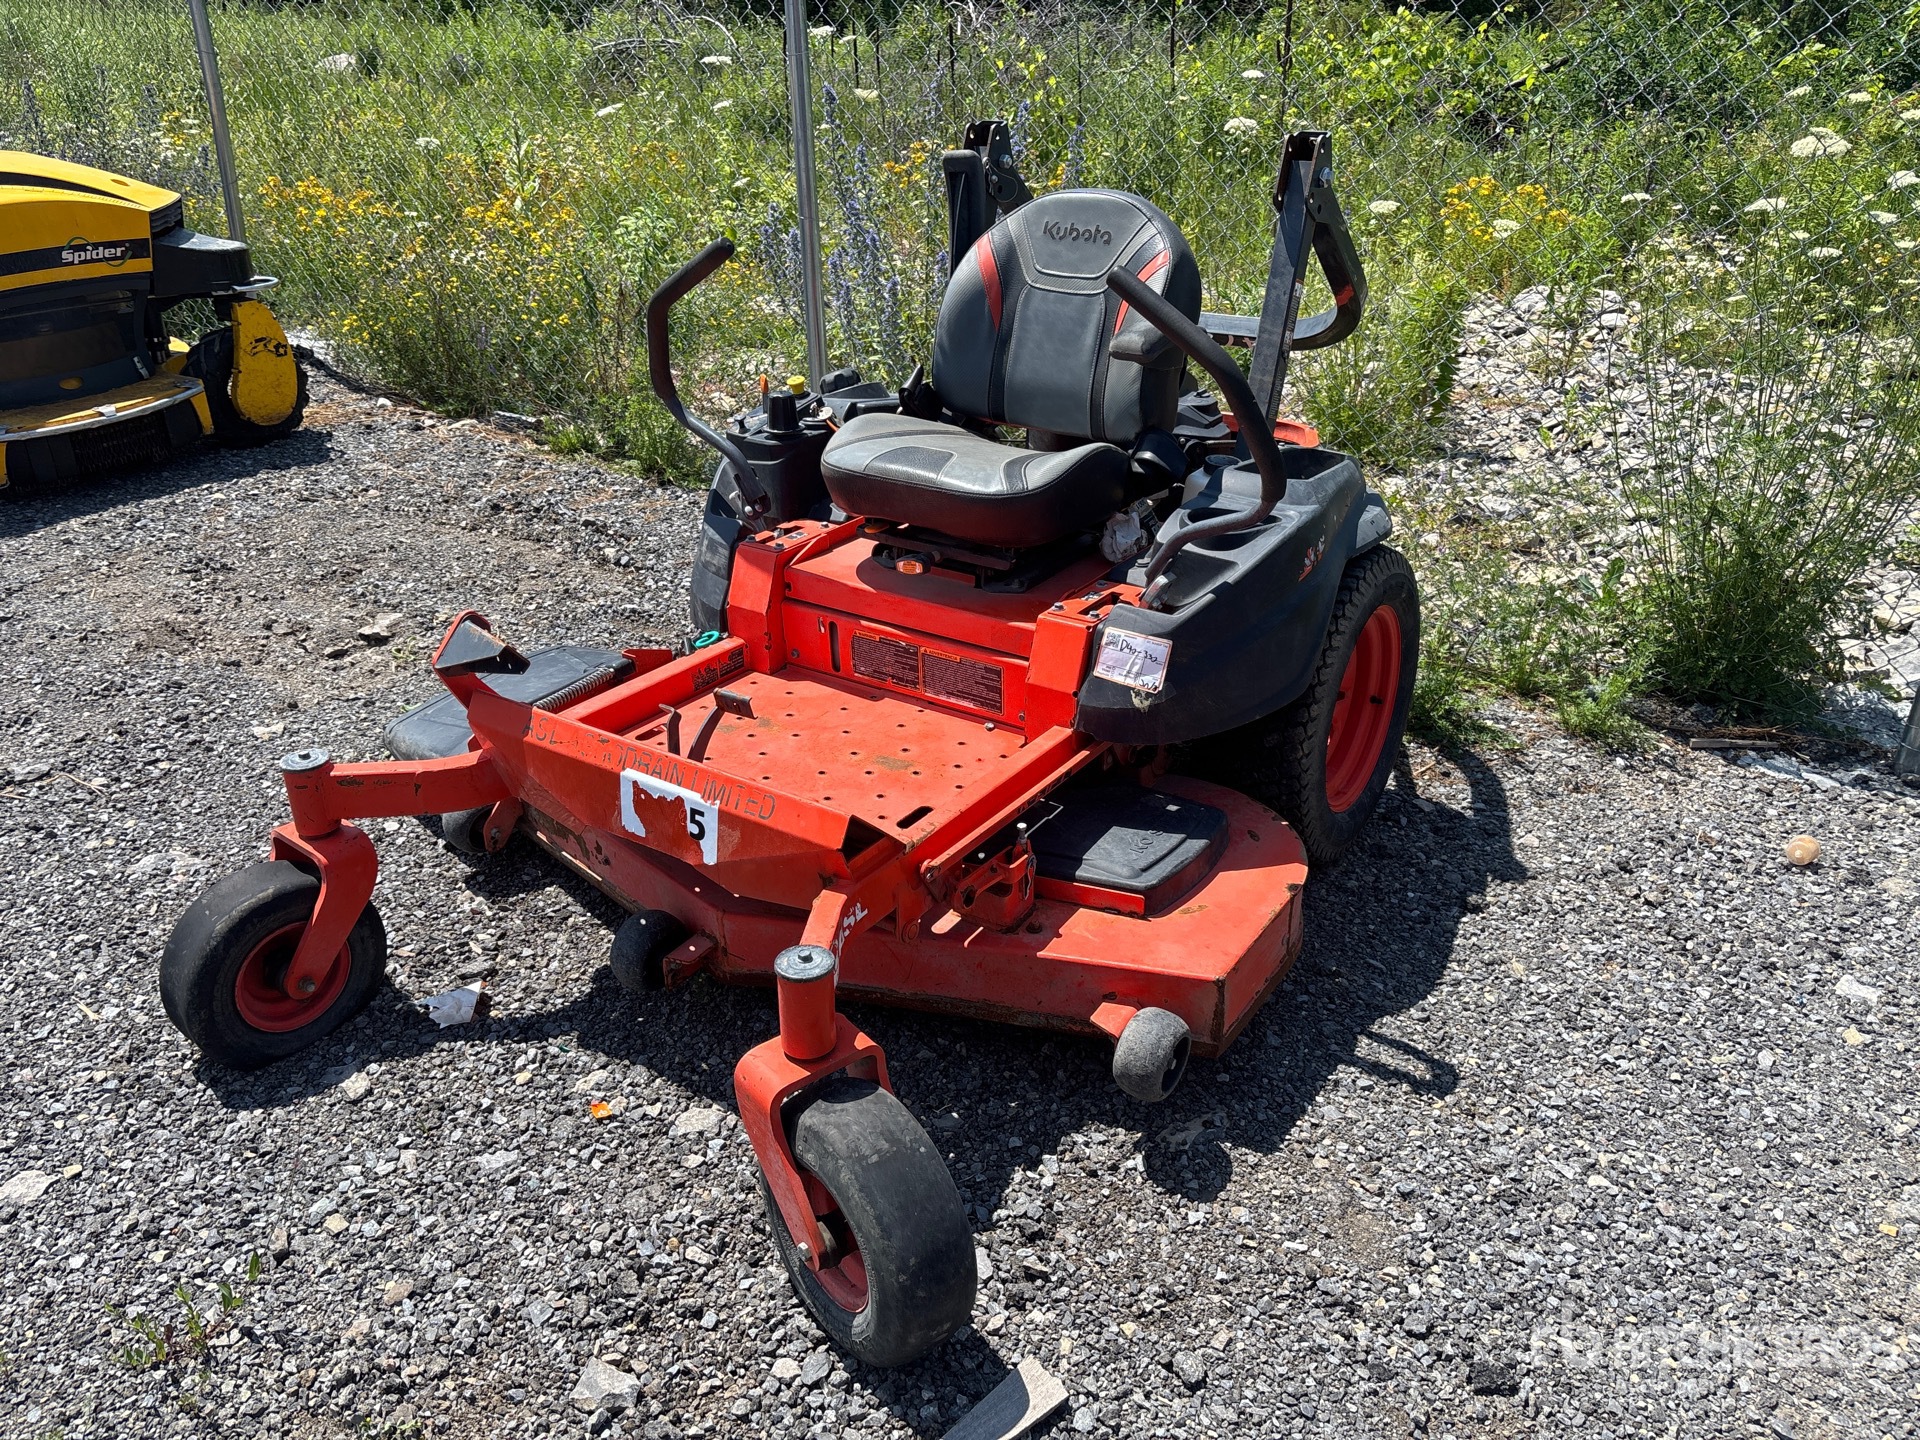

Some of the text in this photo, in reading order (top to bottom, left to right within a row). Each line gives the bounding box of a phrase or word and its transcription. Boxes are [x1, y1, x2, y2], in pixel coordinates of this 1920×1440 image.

[1043, 220, 1113, 246] Kubota
[61, 245, 126, 265] Spider
[690, 769, 776, 821] LIMITED
[689, 806, 706, 841] 5
